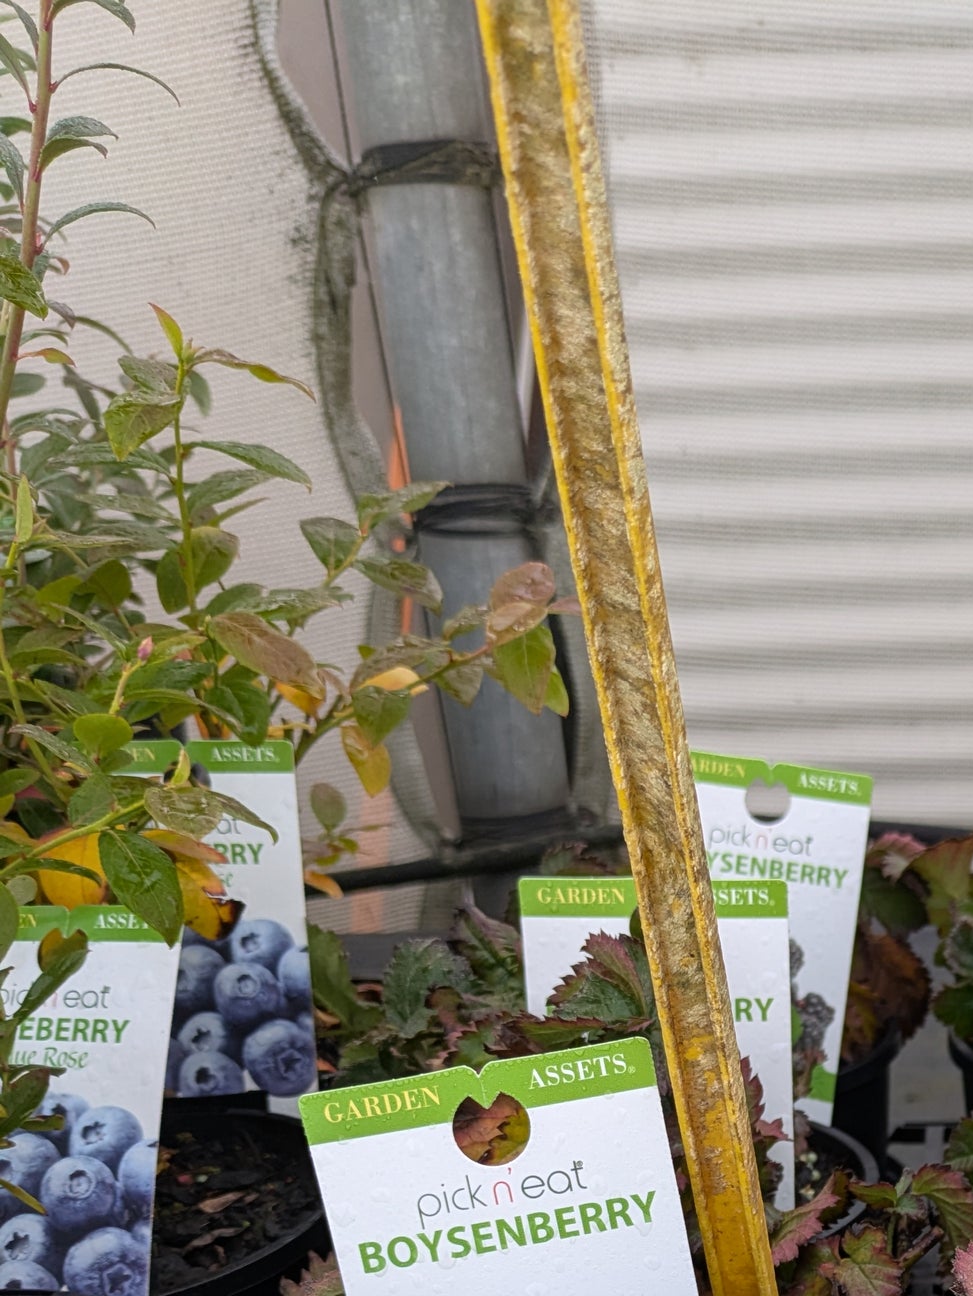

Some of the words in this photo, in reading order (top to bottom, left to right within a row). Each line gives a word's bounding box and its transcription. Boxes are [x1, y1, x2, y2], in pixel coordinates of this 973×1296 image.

[211, 746, 276, 762] ASSETS
[798, 772, 859, 796] ASSETS
[708, 823, 752, 849] pick
[706, 850, 849, 889] YSENBERRY
[536, 887, 625, 905] GARDEN
[712, 888, 769, 906] SETS
[93, 913, 150, 929] ASSE
[18, 1016, 131, 1044] EBERRY
[43, 1046, 89, 1069] Rose
[323, 1084, 441, 1124] GARDEN
[528, 1052, 628, 1090] ASSETS
[417, 1174, 487, 1230] pick
[521, 1160, 589, 1200] eat
[357, 1189, 657, 1275] BOYSENBERRY
